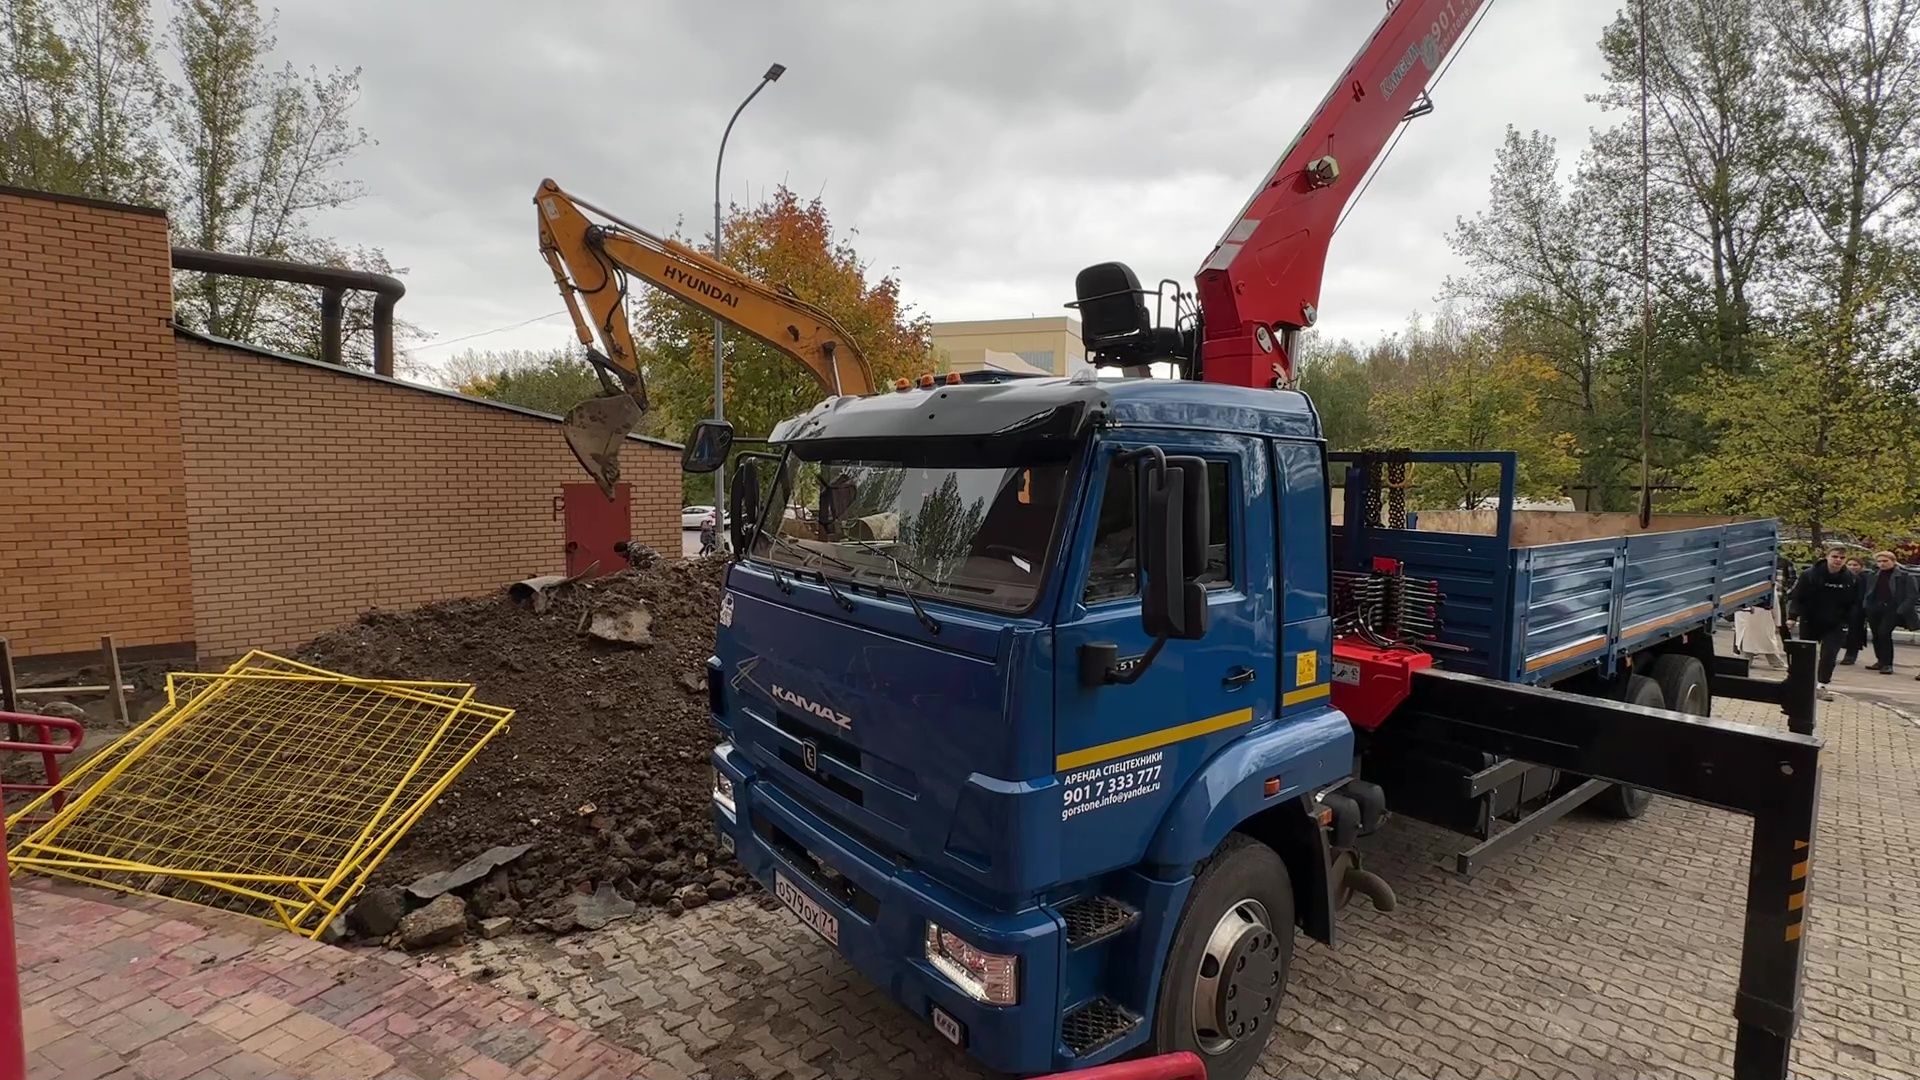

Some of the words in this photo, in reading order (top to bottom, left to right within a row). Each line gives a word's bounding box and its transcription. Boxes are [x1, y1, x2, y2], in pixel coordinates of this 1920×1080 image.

[1431, 0, 1456, 42] 901
[664, 265, 739, 308] HYUNDAI
[771, 684, 852, 731] KAMAZ
[1063, 767, 1102, 786] АРЕНДА
[1102, 751, 1163, 776] СПЕЦТЕХНИКИ
[1063, 784, 1091, 806] 901
[1095, 780, 1105, 797] 7
[1107, 773, 1134, 794] 333
[1137, 764, 1162, 785] 777
[1061, 781, 1161, 822] gorstone.info@yandex.ru
